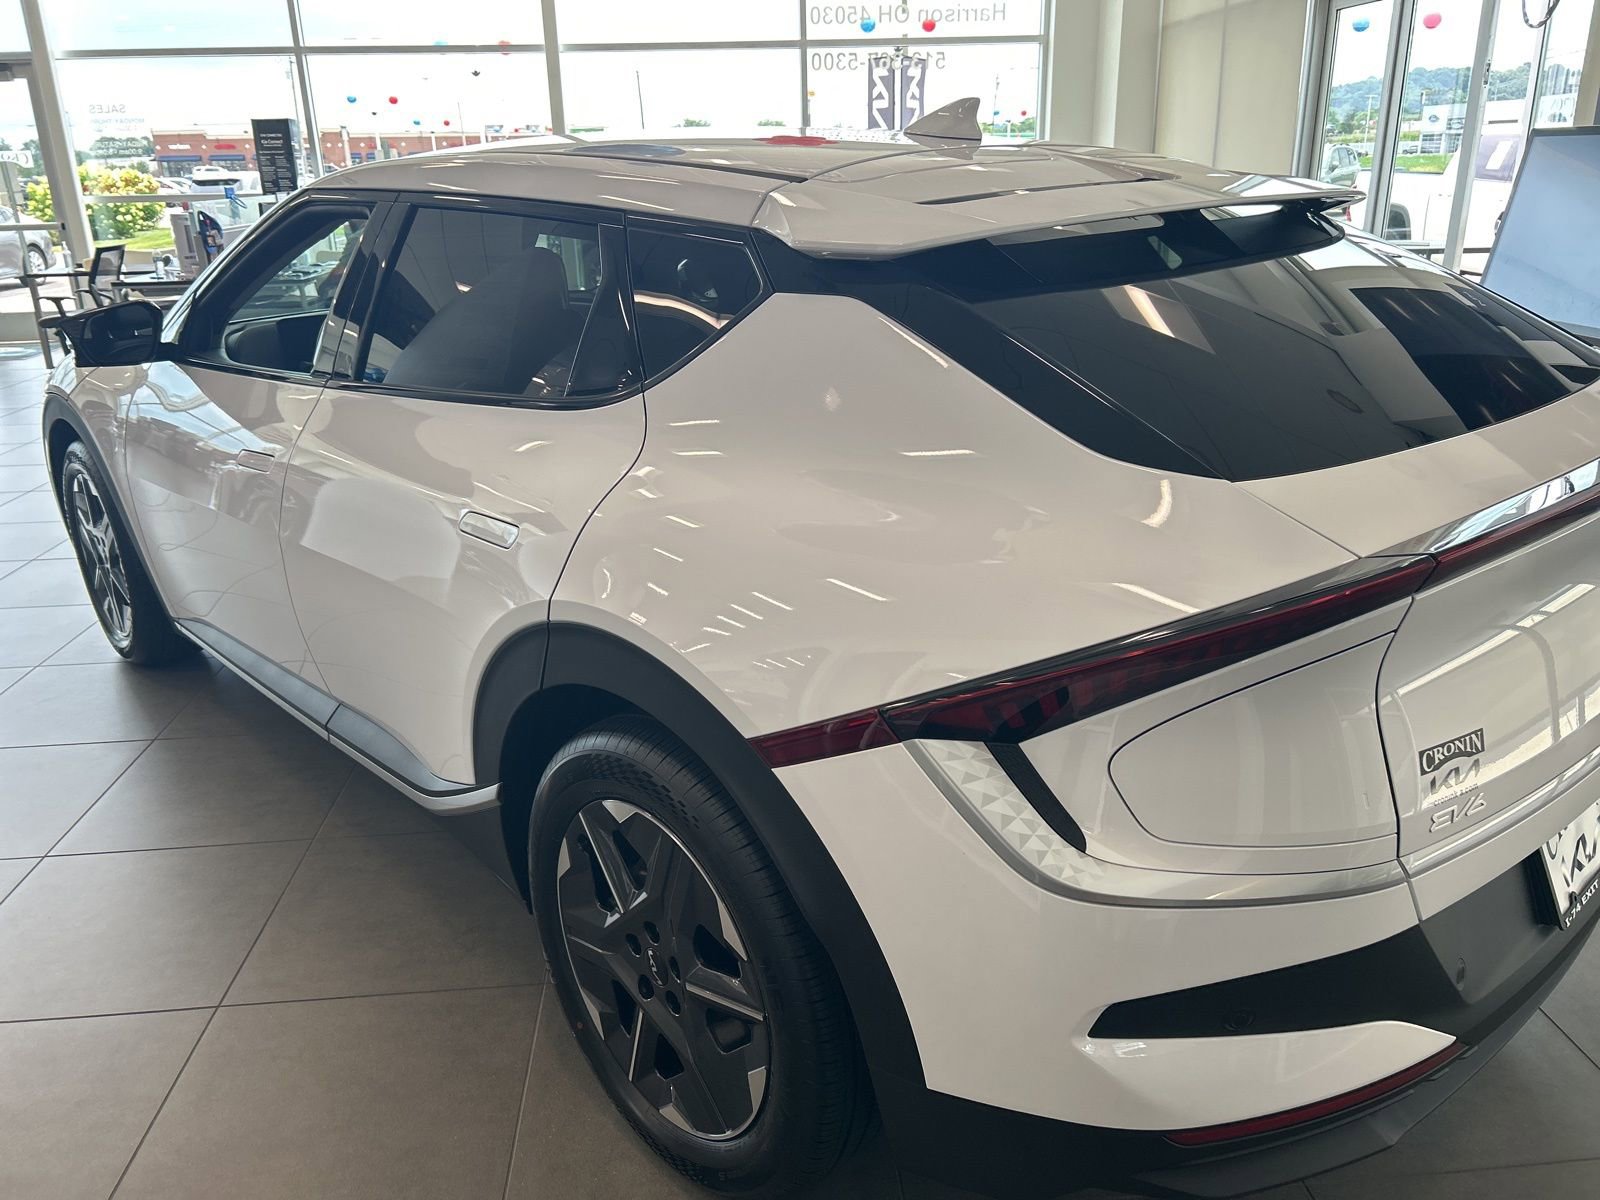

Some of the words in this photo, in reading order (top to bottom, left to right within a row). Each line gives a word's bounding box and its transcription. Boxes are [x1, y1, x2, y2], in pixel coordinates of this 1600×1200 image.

[1422, 731, 1482, 772] CRONIN
[1430, 758, 1480, 795] KIA
[1434, 783, 1479, 806] croninka.com
[1429, 792, 1487, 833] EV6
[1564, 901, 1581, 928] I-74
[1581, 878, 1600, 905] EXIT
